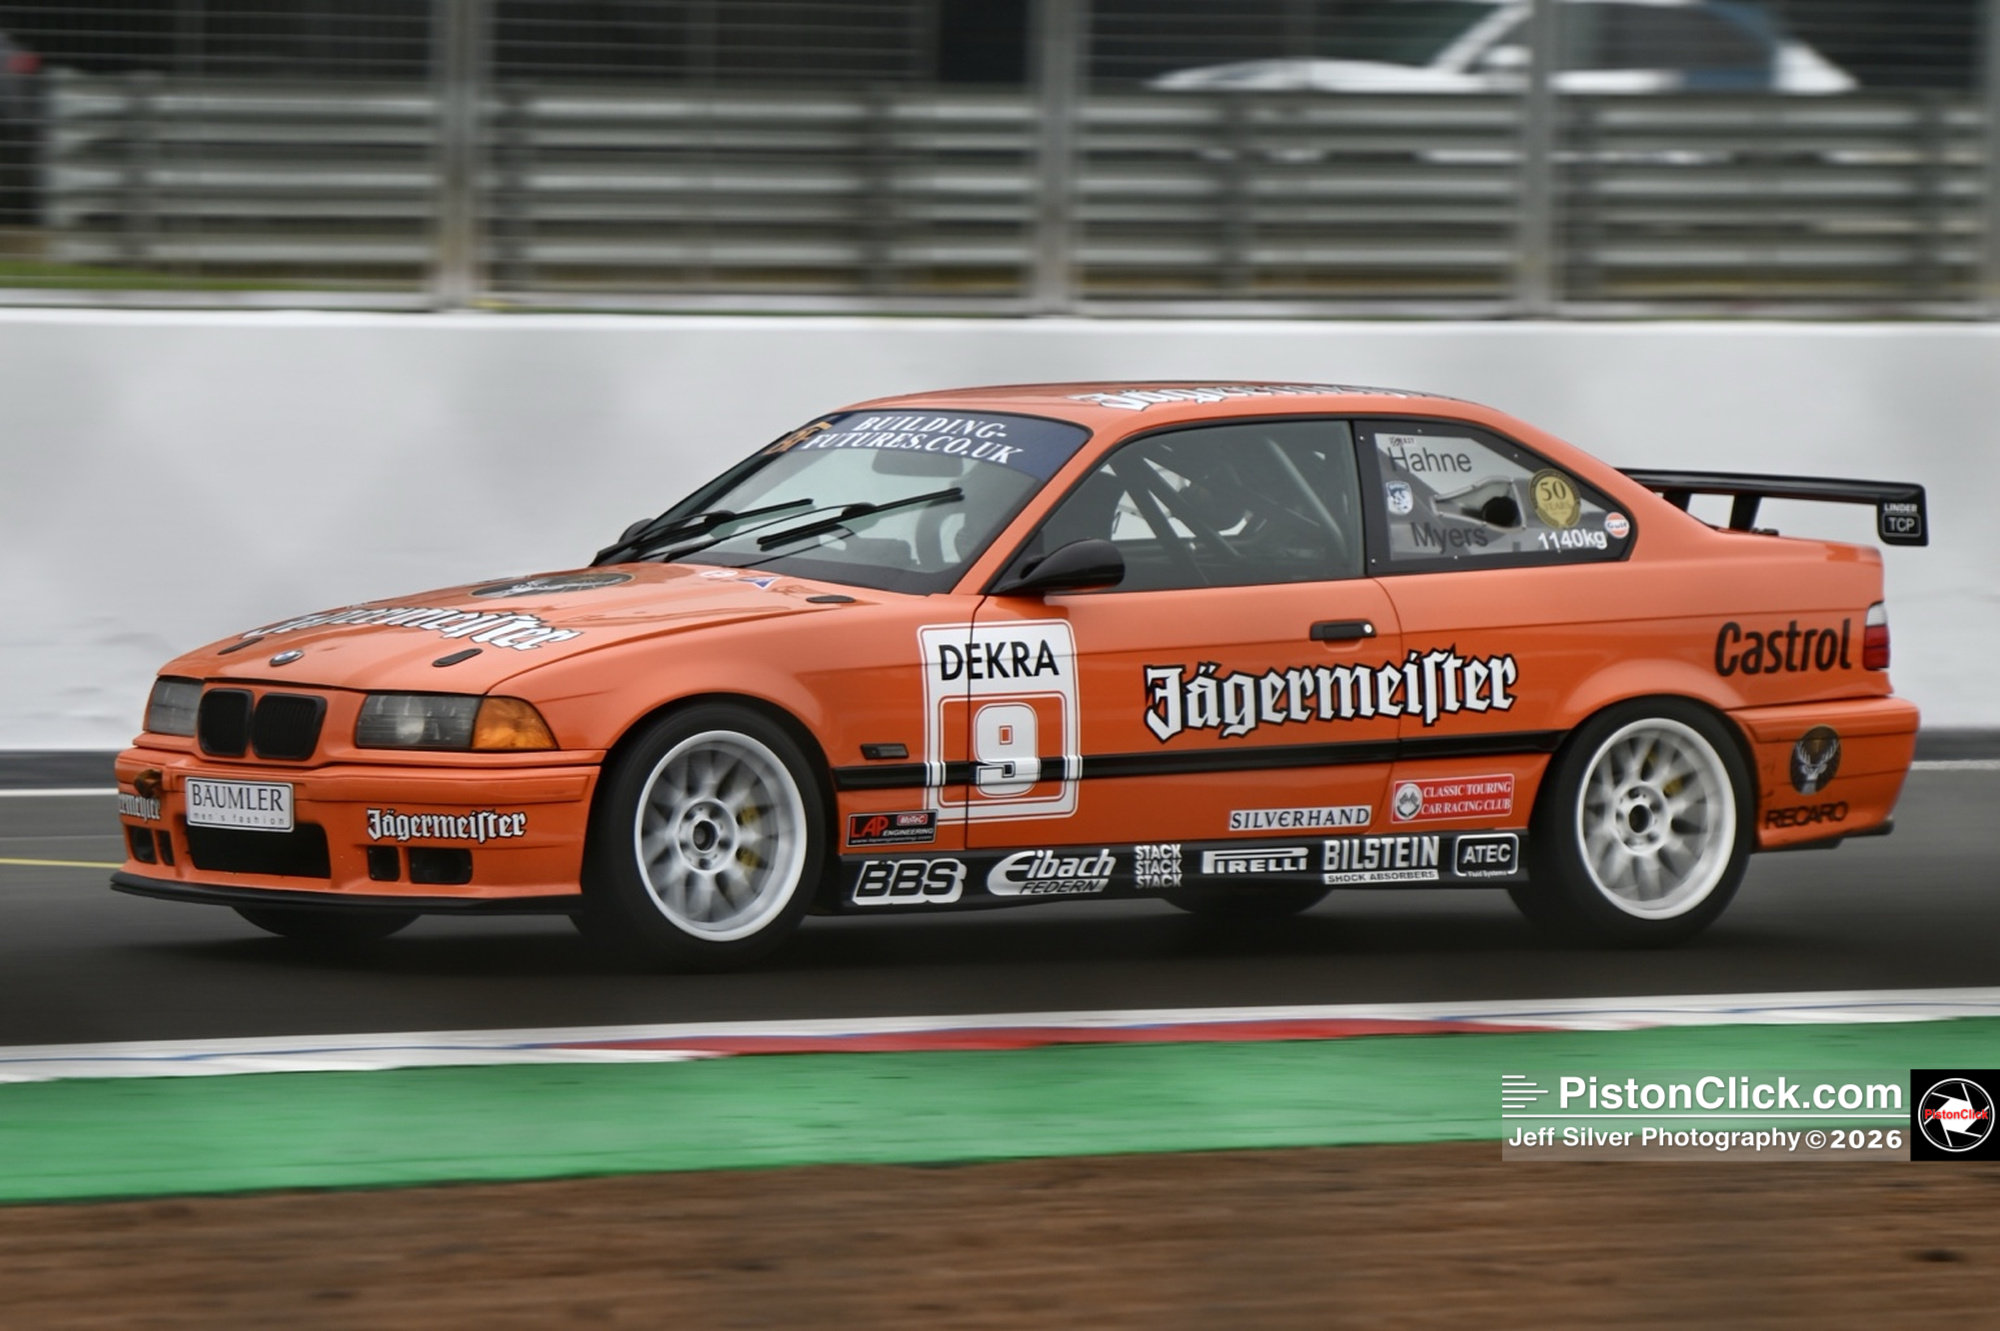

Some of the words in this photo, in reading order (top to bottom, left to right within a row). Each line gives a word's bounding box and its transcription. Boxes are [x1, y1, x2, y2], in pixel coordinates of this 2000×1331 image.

[853, 416, 1006, 439] BUILDING-
[801, 432, 1023, 464] FUTURES.CO.UK
[1387, 447, 1472, 473] Hahne
[1540, 480, 1566, 502] 50
[1888, 516, 1915, 532] TCP
[1411, 522, 1488, 554] Myers
[1538, 529, 1607, 550] 1140kg
[1715, 618, 1852, 677] Castrol
[938, 639, 1060, 681] DEKRA
[974, 702, 1041, 798] 9
[1423, 785, 1464, 798] CLASSIC
[1466, 781, 1511, 794] TOURING
[1421, 803, 1442, 815] CAR
[1444, 800, 1482, 813] RACING
[1484, 798, 1511, 811] CLUB
[1765, 802, 1848, 829] RECARO
[233, 814, 285, 825] fashion
[850, 815, 889, 838] LAP
[1231, 808, 1370, 829] SILVERHAND
[883, 828, 934, 837] ENGINEERING
[1135, 844, 1182, 860] STACK
[1202, 847, 1309, 874] PIRELLI
[1323, 836, 1440, 871] BILSTEIN
[1463, 844, 1511, 864] ATEC
[987, 848, 1116, 894] Eibach
[1135, 859, 1182, 875] STACK
[1328, 872, 1367, 883] SHOCK
[1369, 870, 1436, 881] ABSORBERS
[853, 858, 967, 905] BBS
[1019, 880, 1099, 895] FEDERN
[1135, 874, 1182, 889] STACK
